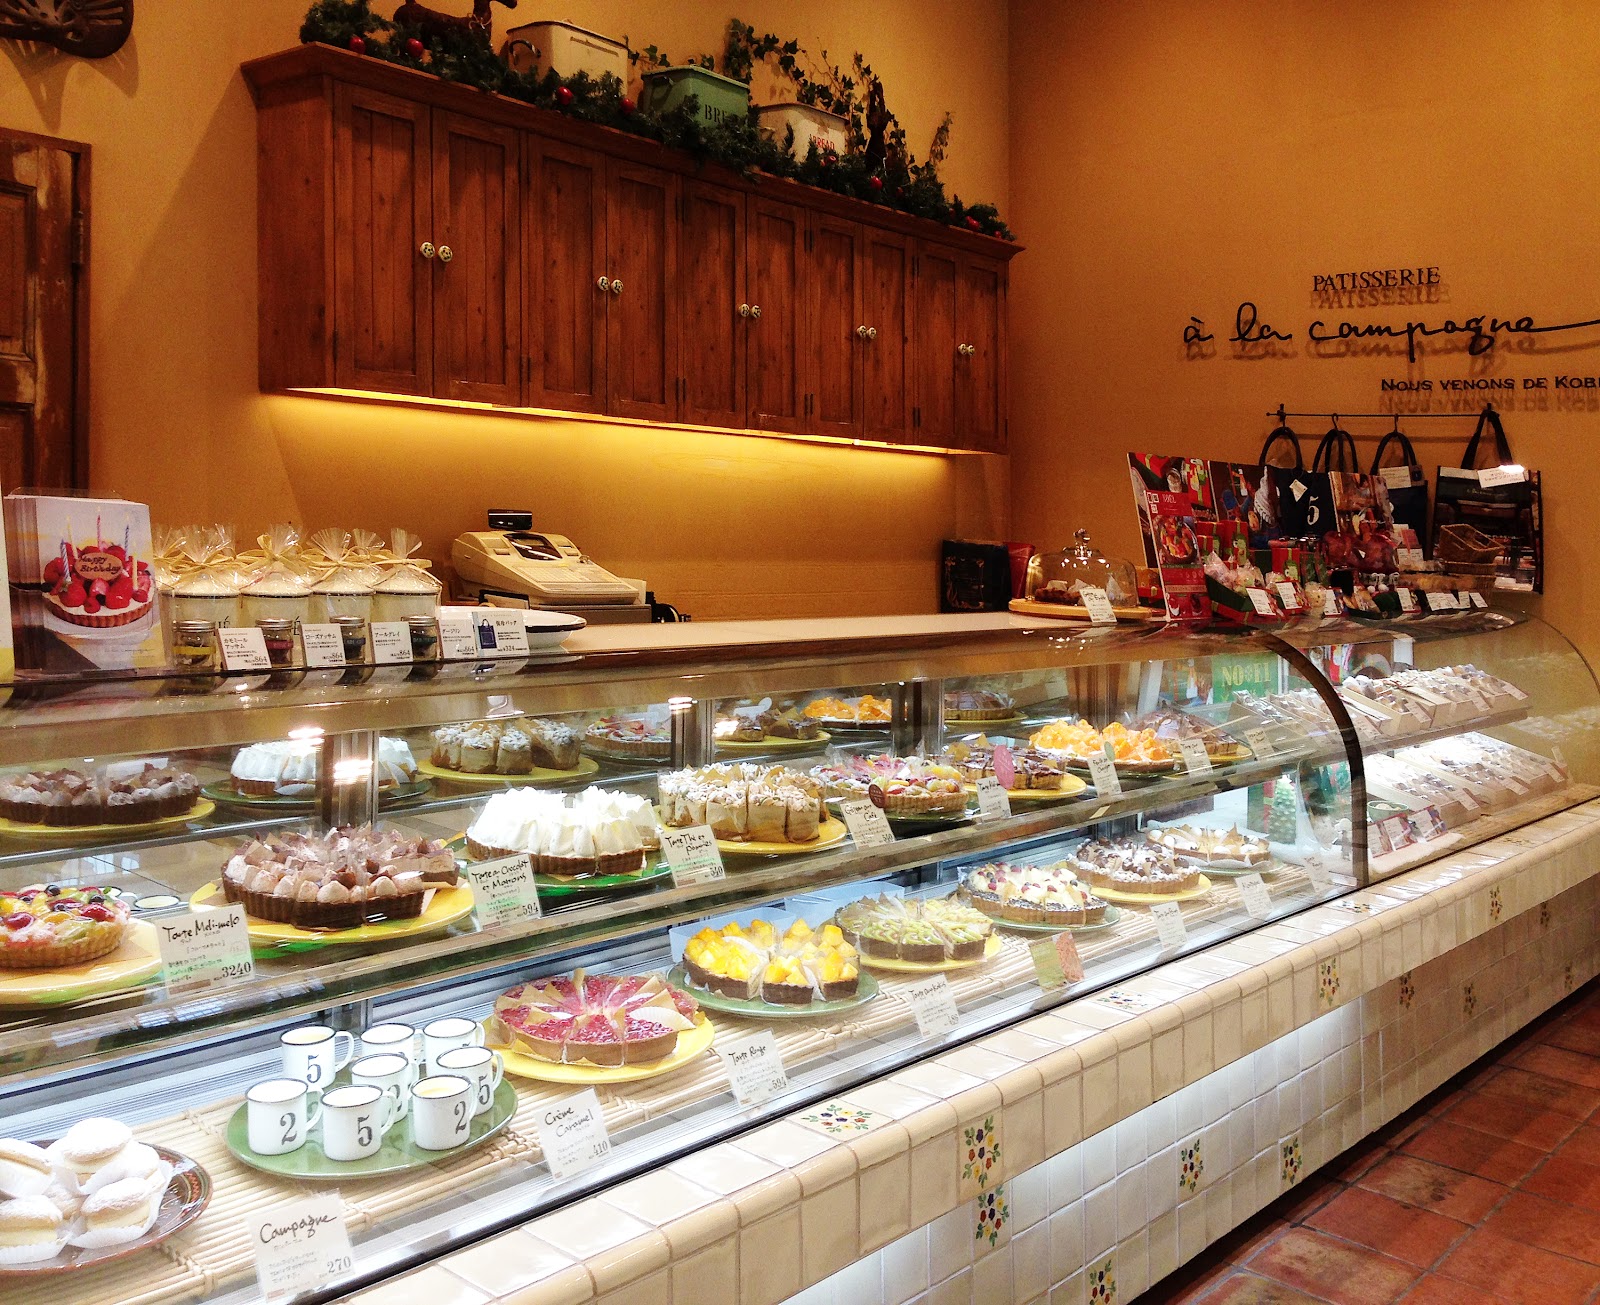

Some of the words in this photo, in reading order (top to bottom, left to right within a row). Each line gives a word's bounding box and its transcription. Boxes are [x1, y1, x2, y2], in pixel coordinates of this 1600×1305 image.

[1312, 266, 1441, 292] PATISSERIE
[1183, 316, 1214, 343] à
[1229, 302, 1293, 343] la
[1309, 314, 1600, 363] campagne
[1555, 375, 1600, 389] KOB
[1307, 495, 1320, 525] 5
[522, 902, 539, 915] 594
[162, 926, 193, 942] Tarte
[221, 961, 252, 978] 3240
[306, 1054, 322, 1084] 5
[477, 1073, 491, 1106] 5
[279, 1112, 298, 1146] 2
[357, 1115, 374, 1147] 5
[454, 1100, 468, 1134] 2
[593, 1140, 608, 1156] 410
[260, 1214, 337, 1244] Campagne
[327, 1255, 351, 1274] 270
